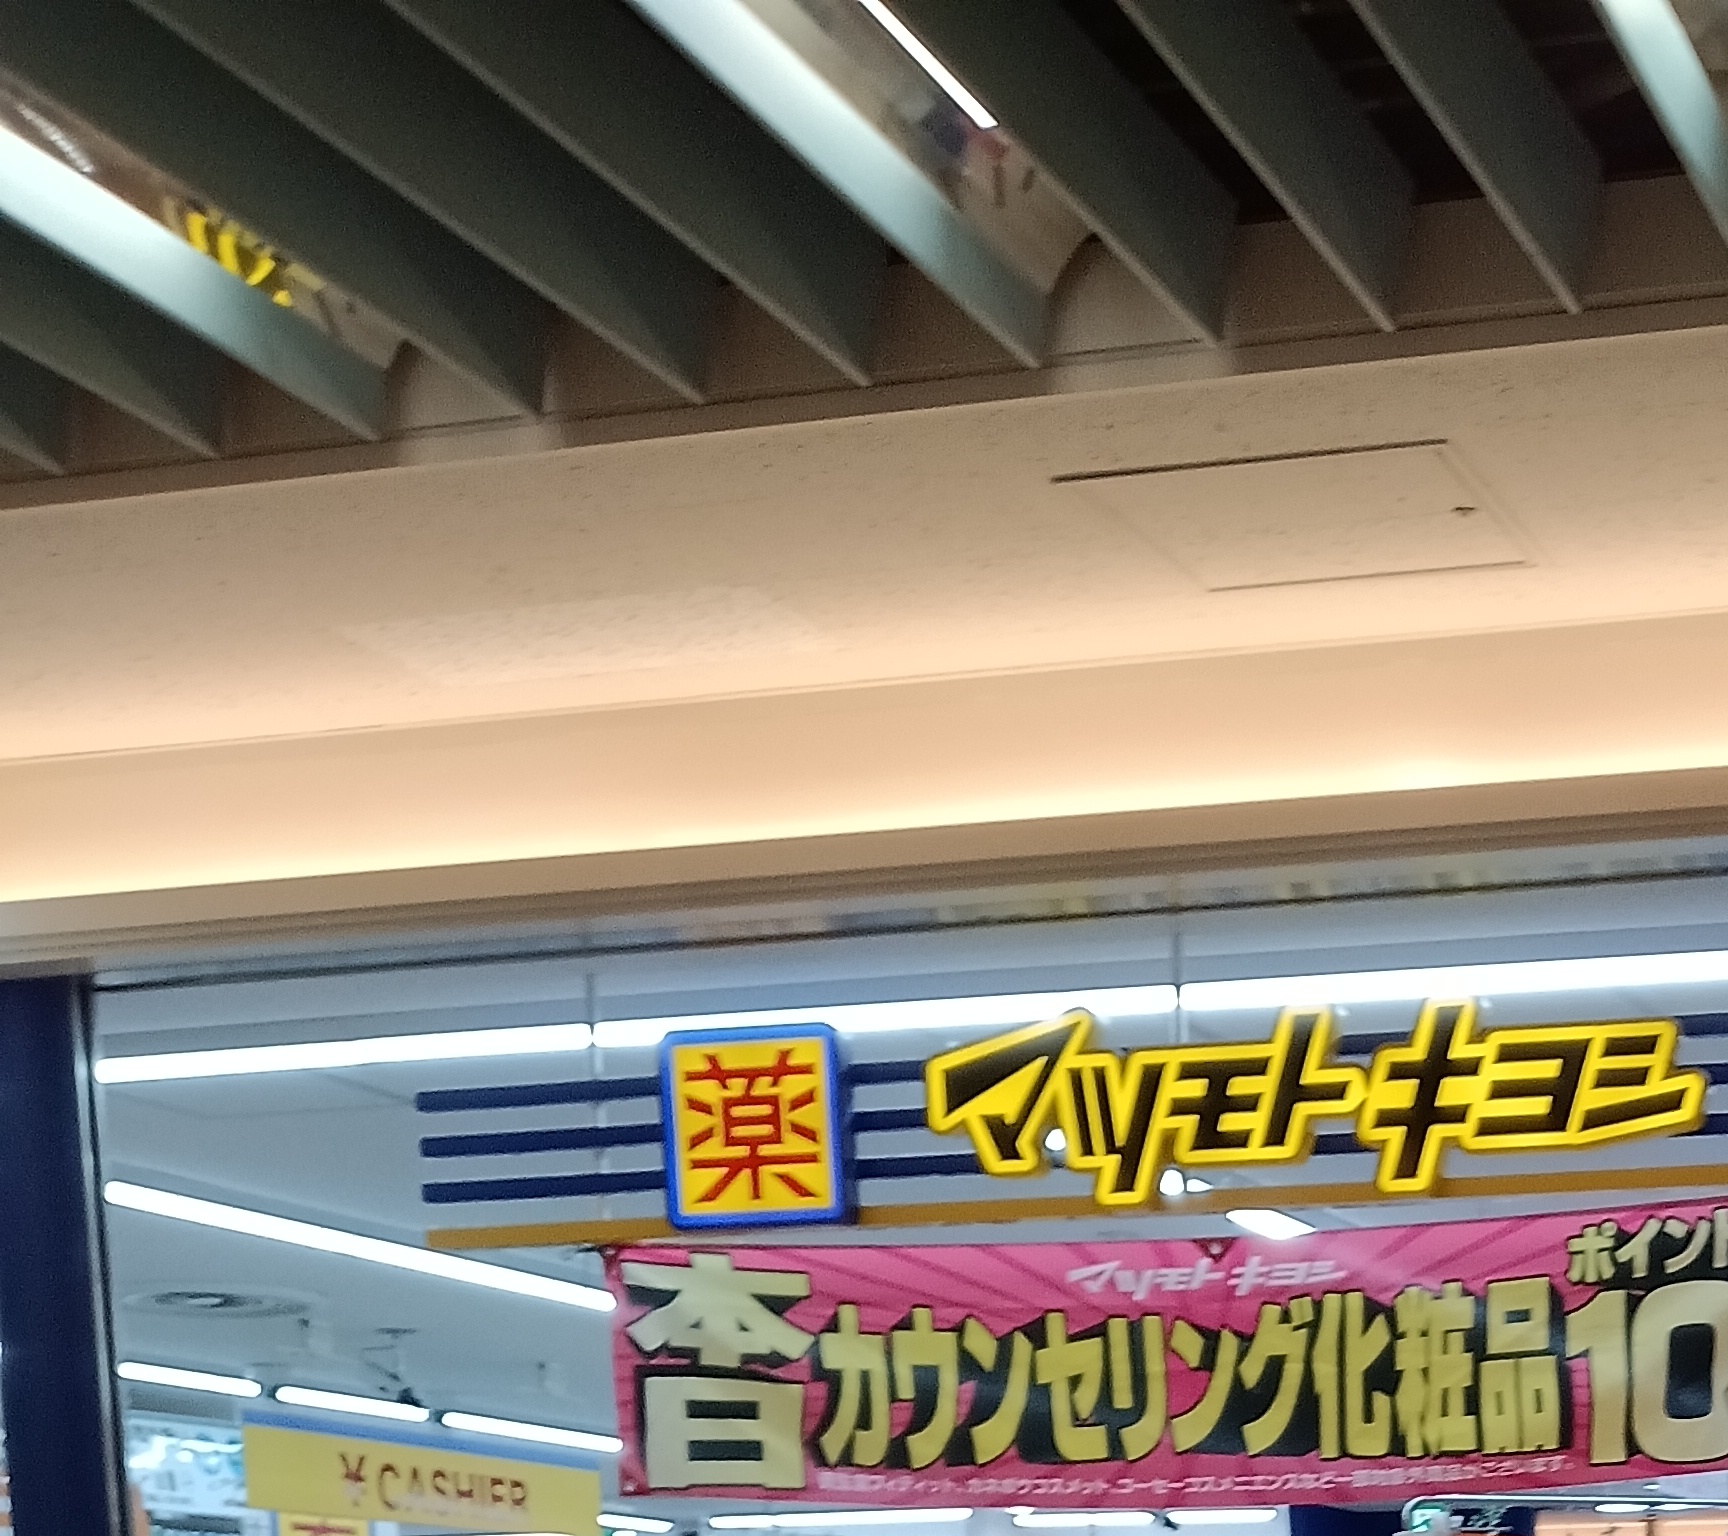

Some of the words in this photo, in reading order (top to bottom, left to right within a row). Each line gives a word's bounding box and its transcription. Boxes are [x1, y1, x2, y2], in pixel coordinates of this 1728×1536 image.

[686, 1047, 816, 1202] 薬
[926, 998, 1707, 1206] マツモトキヨシ
[1066, 1256, 1350, 1301] マツモトキヨシ
[819, 1276, 1565, 1470] カウンセリング化粧品
[378, 1462, 527, 1511] CASHIER
